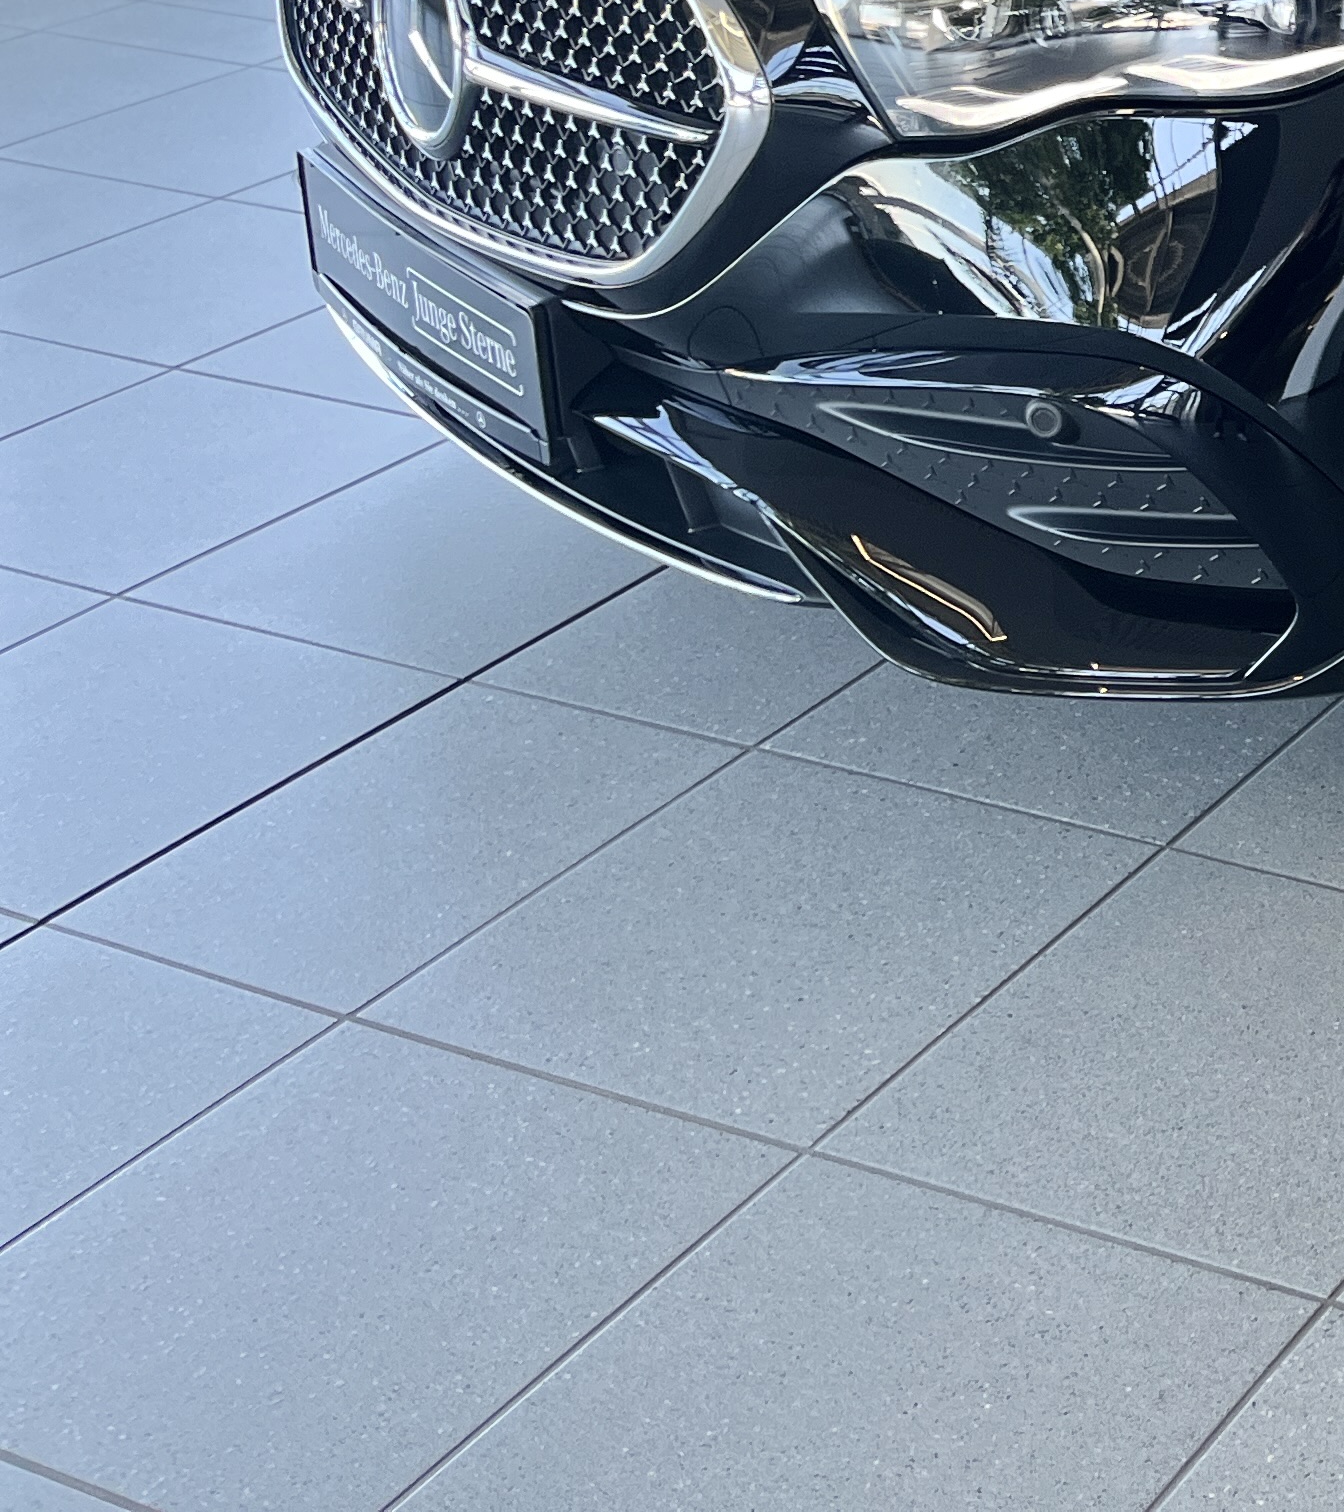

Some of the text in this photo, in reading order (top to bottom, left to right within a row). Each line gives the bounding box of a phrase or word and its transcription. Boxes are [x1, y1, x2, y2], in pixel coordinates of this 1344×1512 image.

[317, 204, 409, 309] Mercedes-Benz
[411, 279, 457, 345] Junge
[457, 310, 518, 378] Sterne
